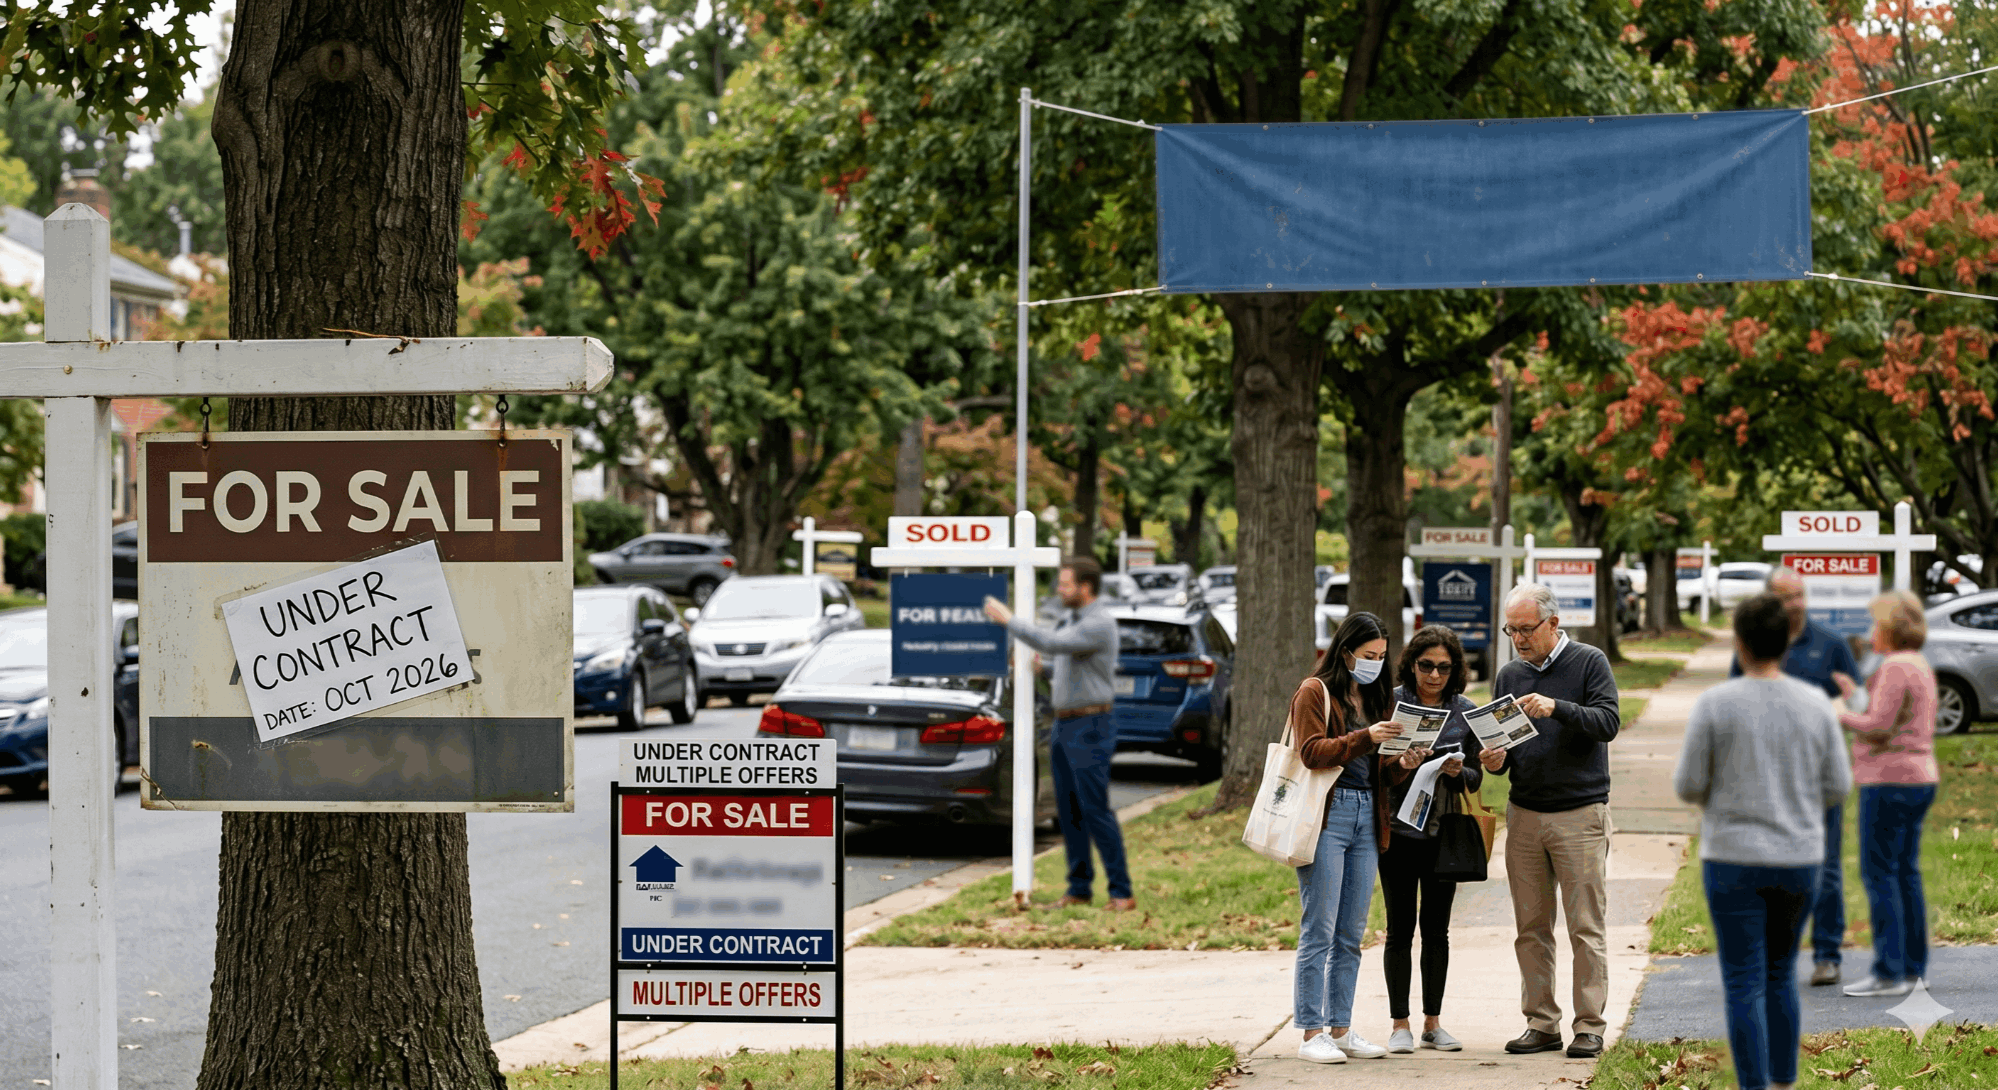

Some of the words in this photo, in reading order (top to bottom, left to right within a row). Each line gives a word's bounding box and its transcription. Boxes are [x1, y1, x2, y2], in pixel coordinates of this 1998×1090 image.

[169, 470, 322, 533] FOR
[347, 469, 541, 533] SALE
[905, 523, 992, 542] SOLD
[1798, 516, 1862, 532] SOLD
[1425, 531, 1452, 543] FOR
[1455, 531, 1488, 544] SALE
[1793, 558, 1825, 572] FOR
[1828, 558, 1869, 573] SALE
[260, 571, 397, 637] UNDER
[899, 608, 936, 623] FOR
[253, 605, 432, 690] CONTRACT
[263, 701, 316, 731] DATE:
[325, 675, 374, 712] OCT
[386, 653, 458, 695] 2026
[633, 742, 703, 761] UNDER
[709, 743, 820, 761] CONTRACT
[635, 766, 732, 783] MULTIPLE
[738, 766, 818, 784] OFFERS
[646, 802, 713, 827] FOR
[723, 802, 810, 828] SALE
[632, 935, 703, 953] UNDER
[709, 936, 822, 955] CONTRACT
[633, 981, 732, 1006] MULTIPLE
[738, 982, 821, 1007] OFFERS
